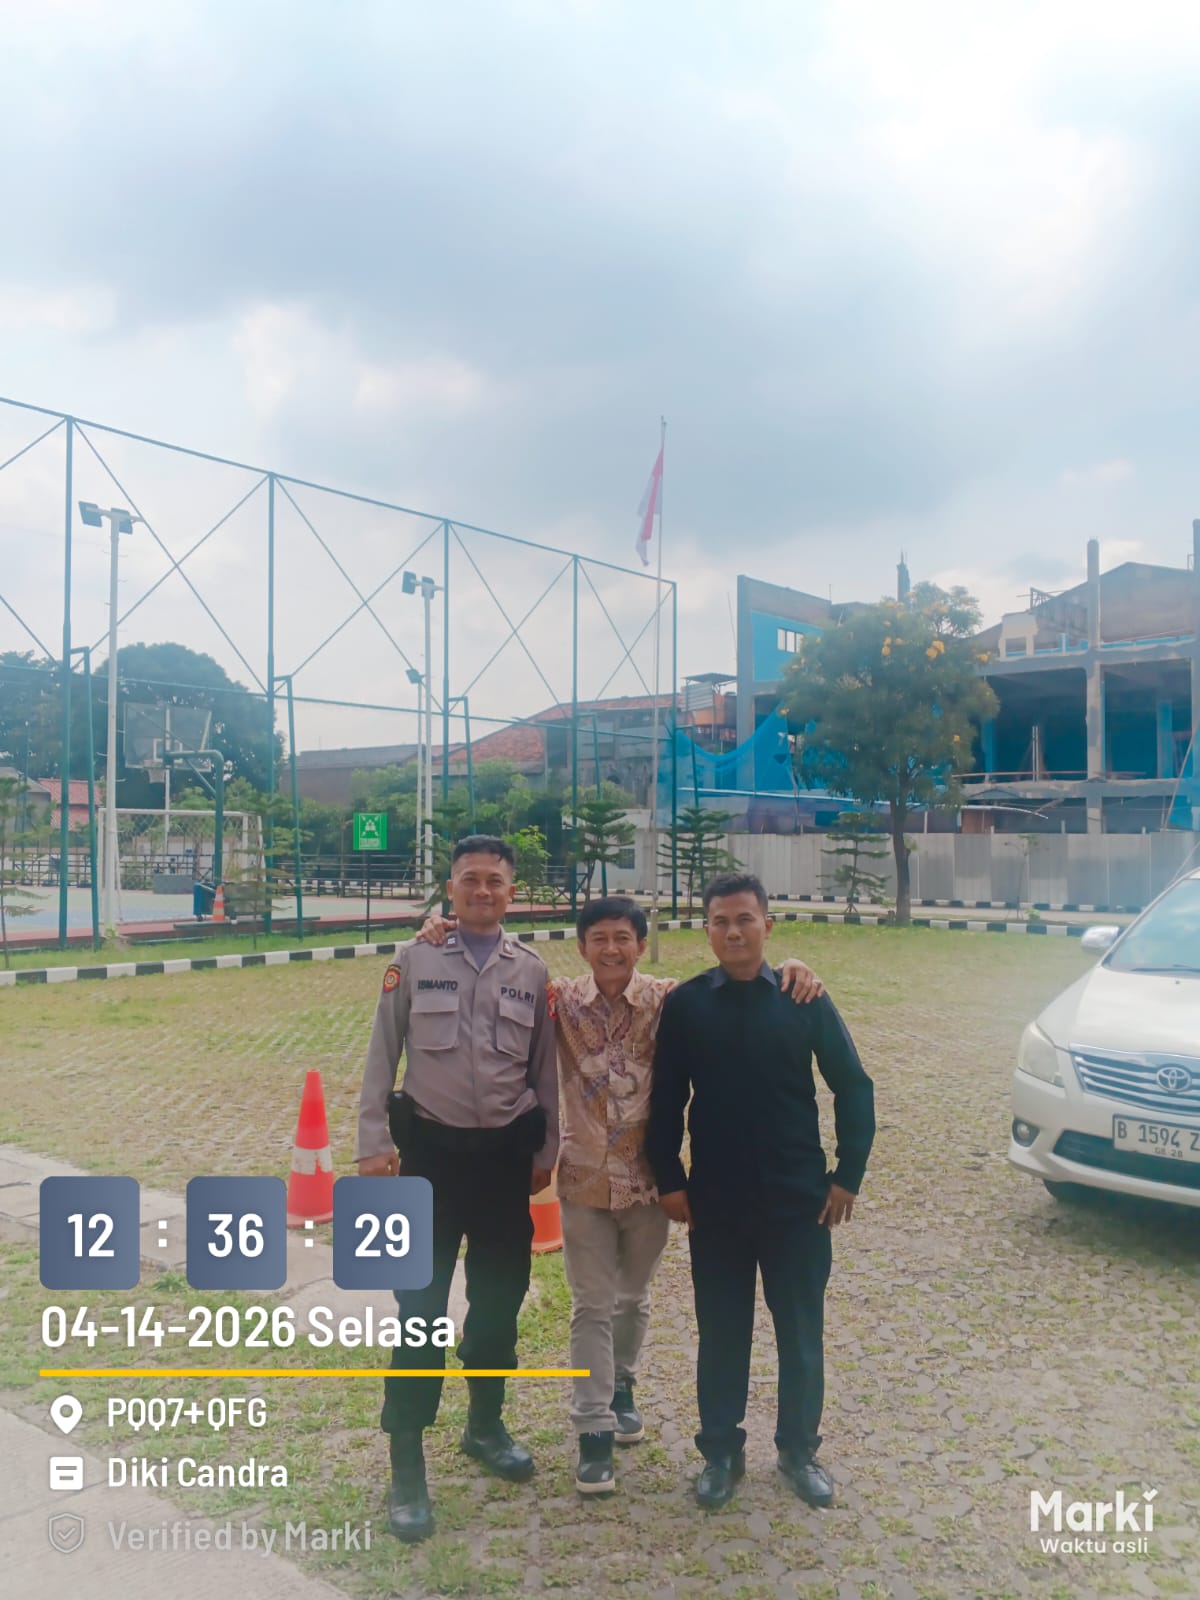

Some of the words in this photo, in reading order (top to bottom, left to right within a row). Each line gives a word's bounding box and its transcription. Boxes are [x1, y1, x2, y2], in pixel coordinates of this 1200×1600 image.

[500, 986, 535, 1004] POLRI
[1117, 1120, 1128, 1139] B
[1138, 1124, 1180, 1147] 1594
